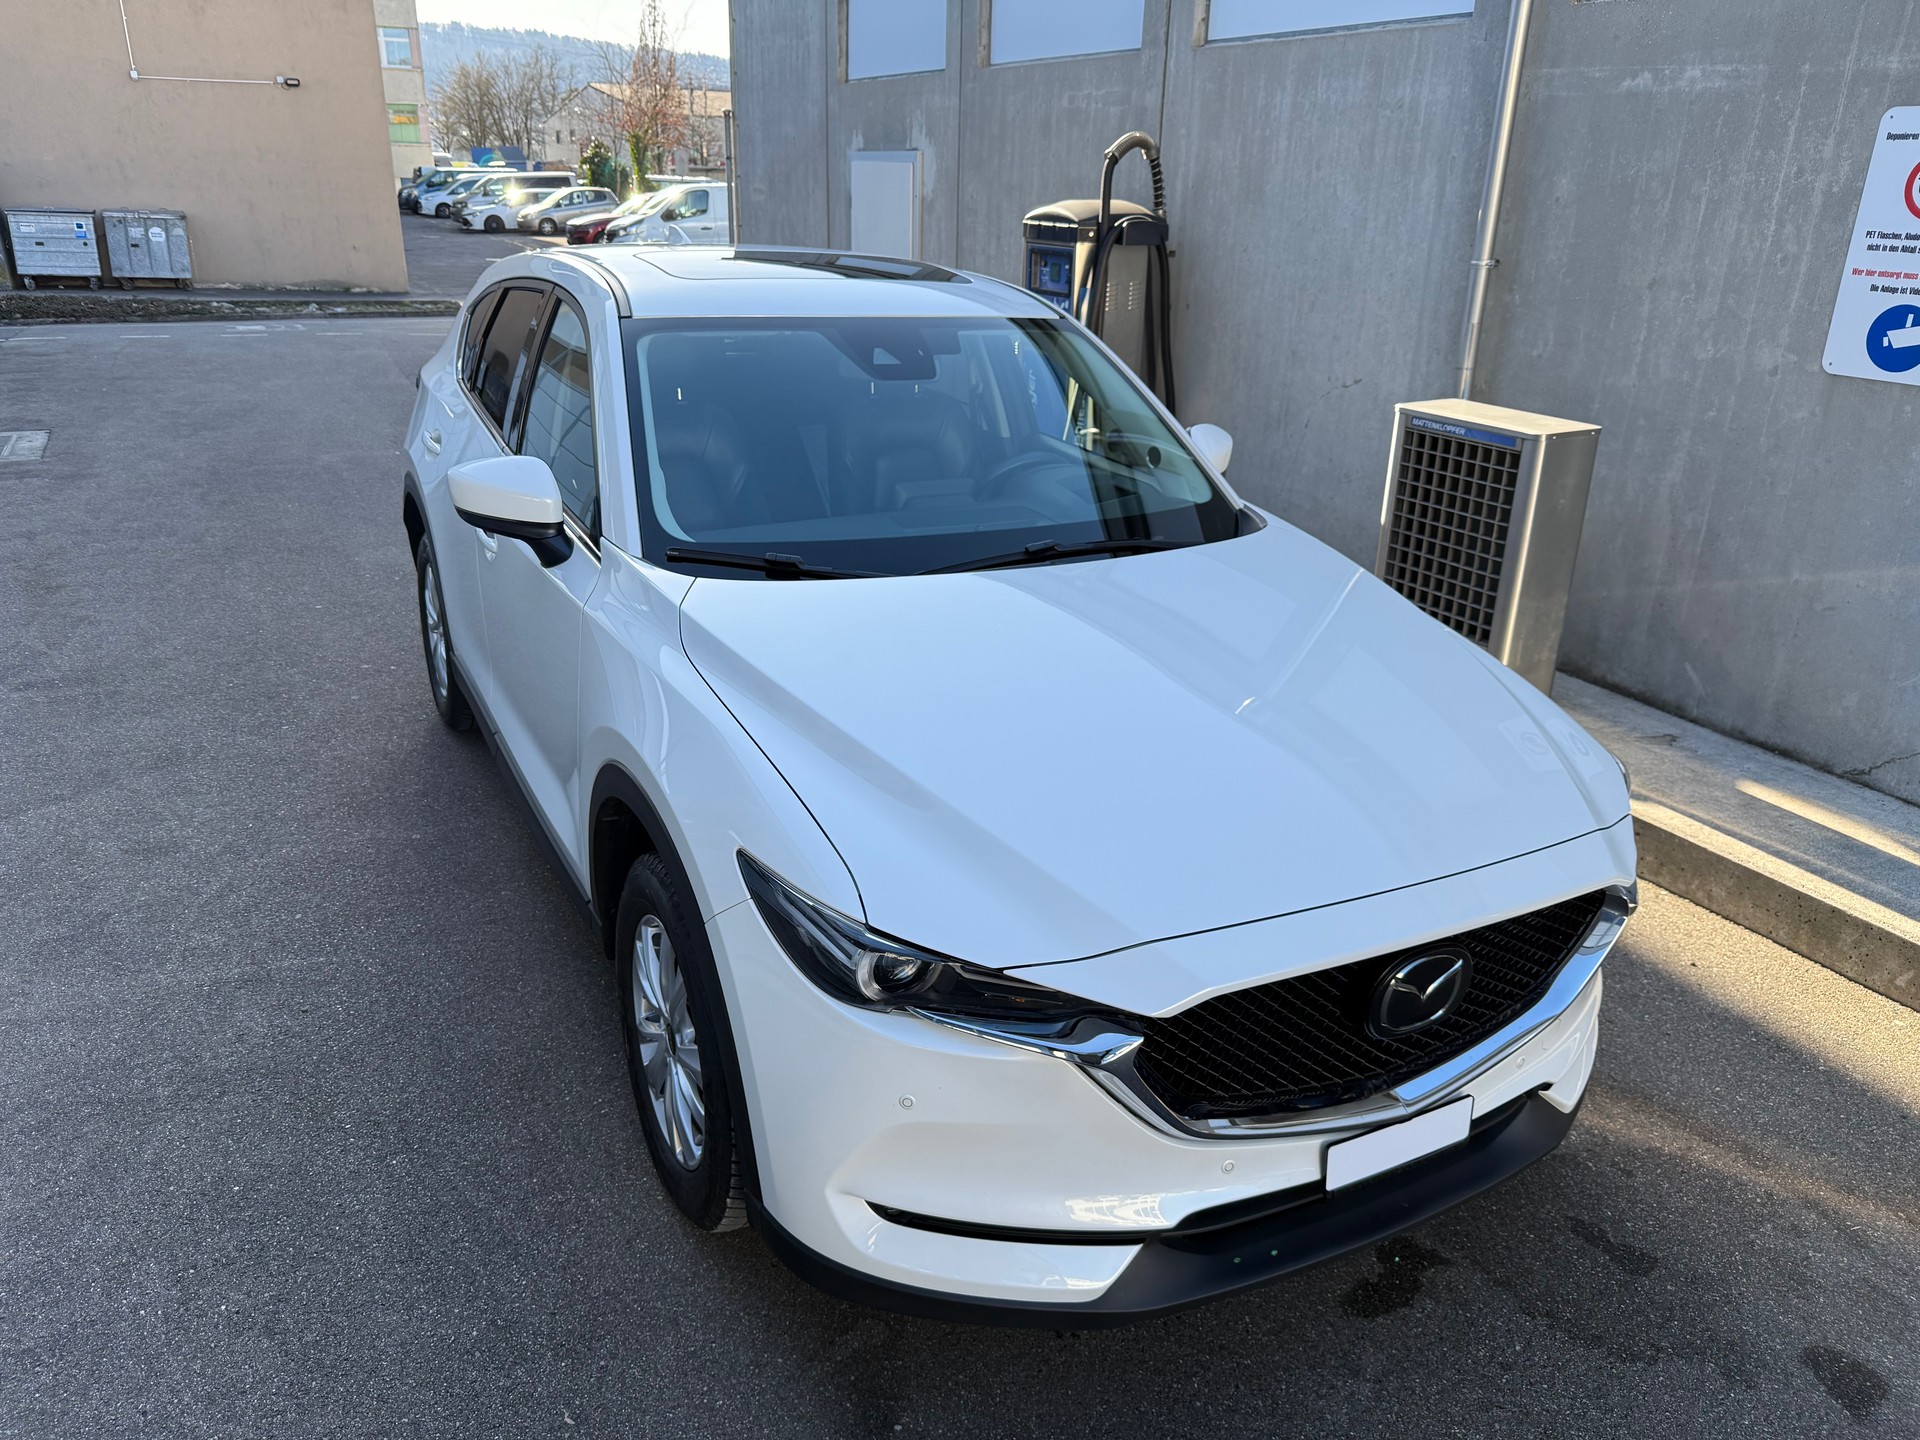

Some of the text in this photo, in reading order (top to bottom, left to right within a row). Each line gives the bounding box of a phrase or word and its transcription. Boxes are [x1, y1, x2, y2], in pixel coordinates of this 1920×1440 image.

[1886, 132, 1920, 141] Deponieren
[1865, 230, 1877, 239] PET
[1877, 231, 1903, 241] Flaschen,
[1867, 243, 1881, 251] nicht
[1882, 244, 1888, 252] in
[1888, 244, 1899, 252] den
[1900, 245, 1917, 254] Abfall
[1852, 267, 1864, 275] Wer
[1878, 270, 1902, 279] entsorgt
[1903, 272, 1918, 280] muss
[1870, 284, 1879, 292] Die
[1880, 285, 1899, 294] Anlage
[1900, 286, 1908, 294] ist
